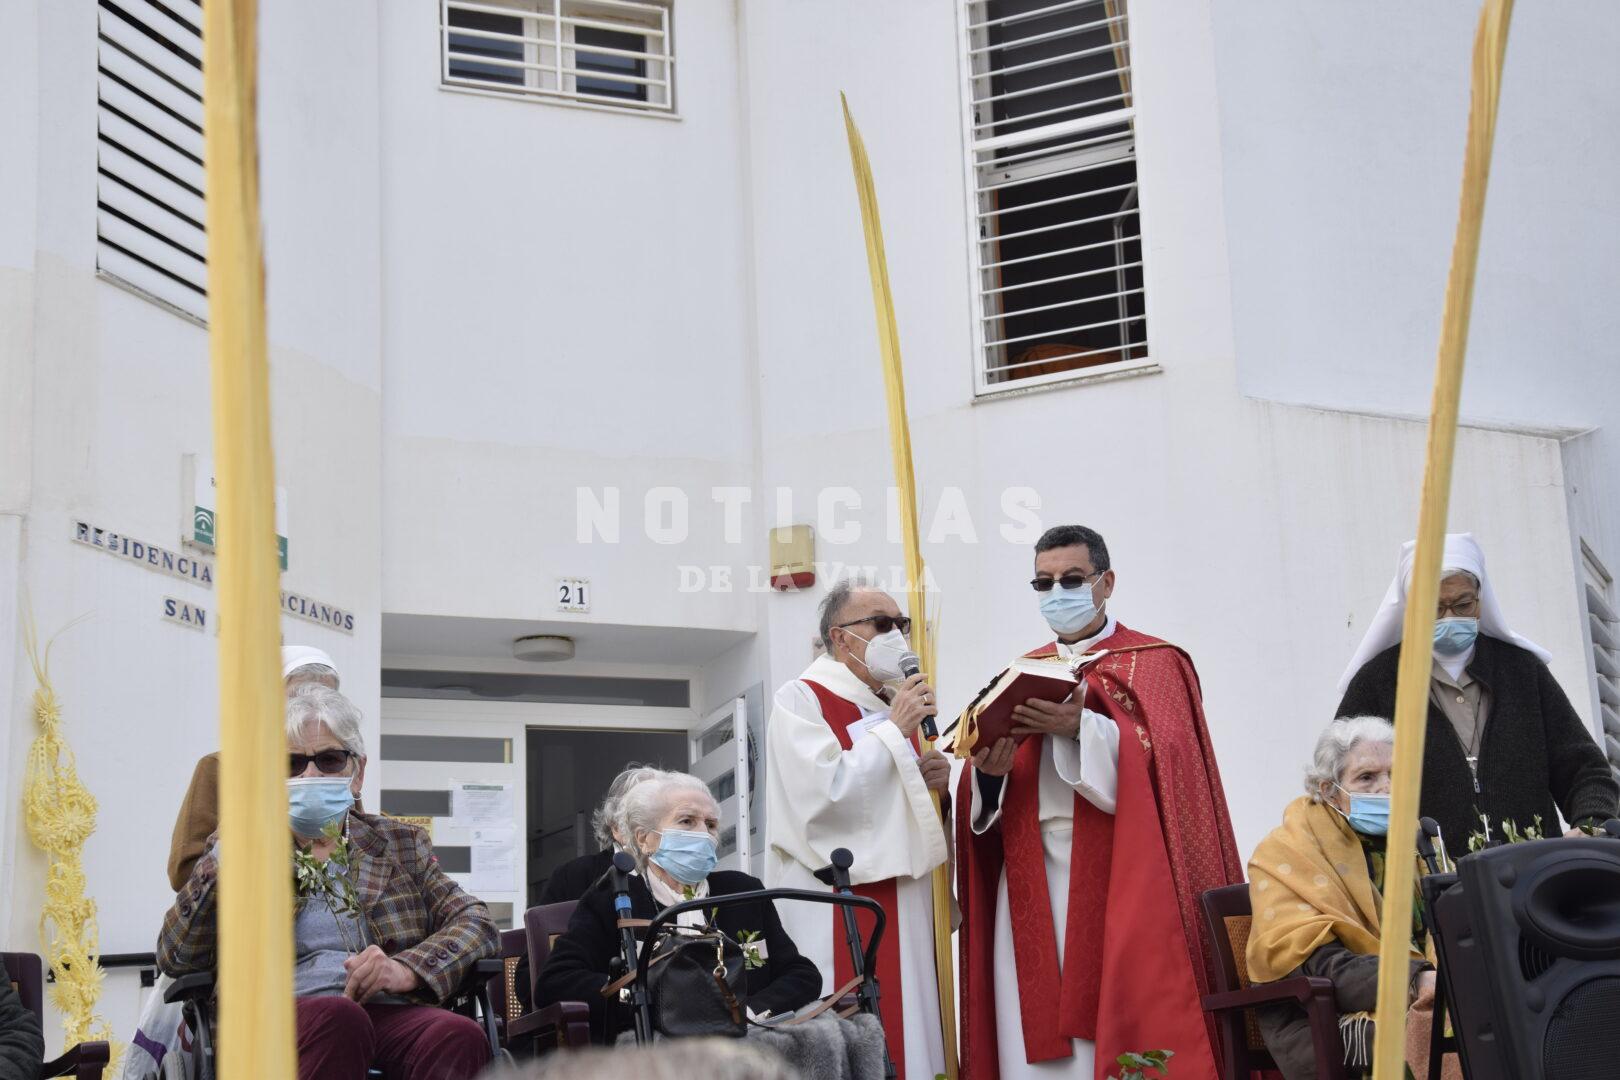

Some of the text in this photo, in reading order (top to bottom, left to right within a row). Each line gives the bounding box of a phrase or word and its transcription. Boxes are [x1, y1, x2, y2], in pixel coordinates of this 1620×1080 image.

[77, 522, 212, 582] RESIDENCIA
[560, 585, 585, 605] 21
[165, 599, 206, 626] SAN
